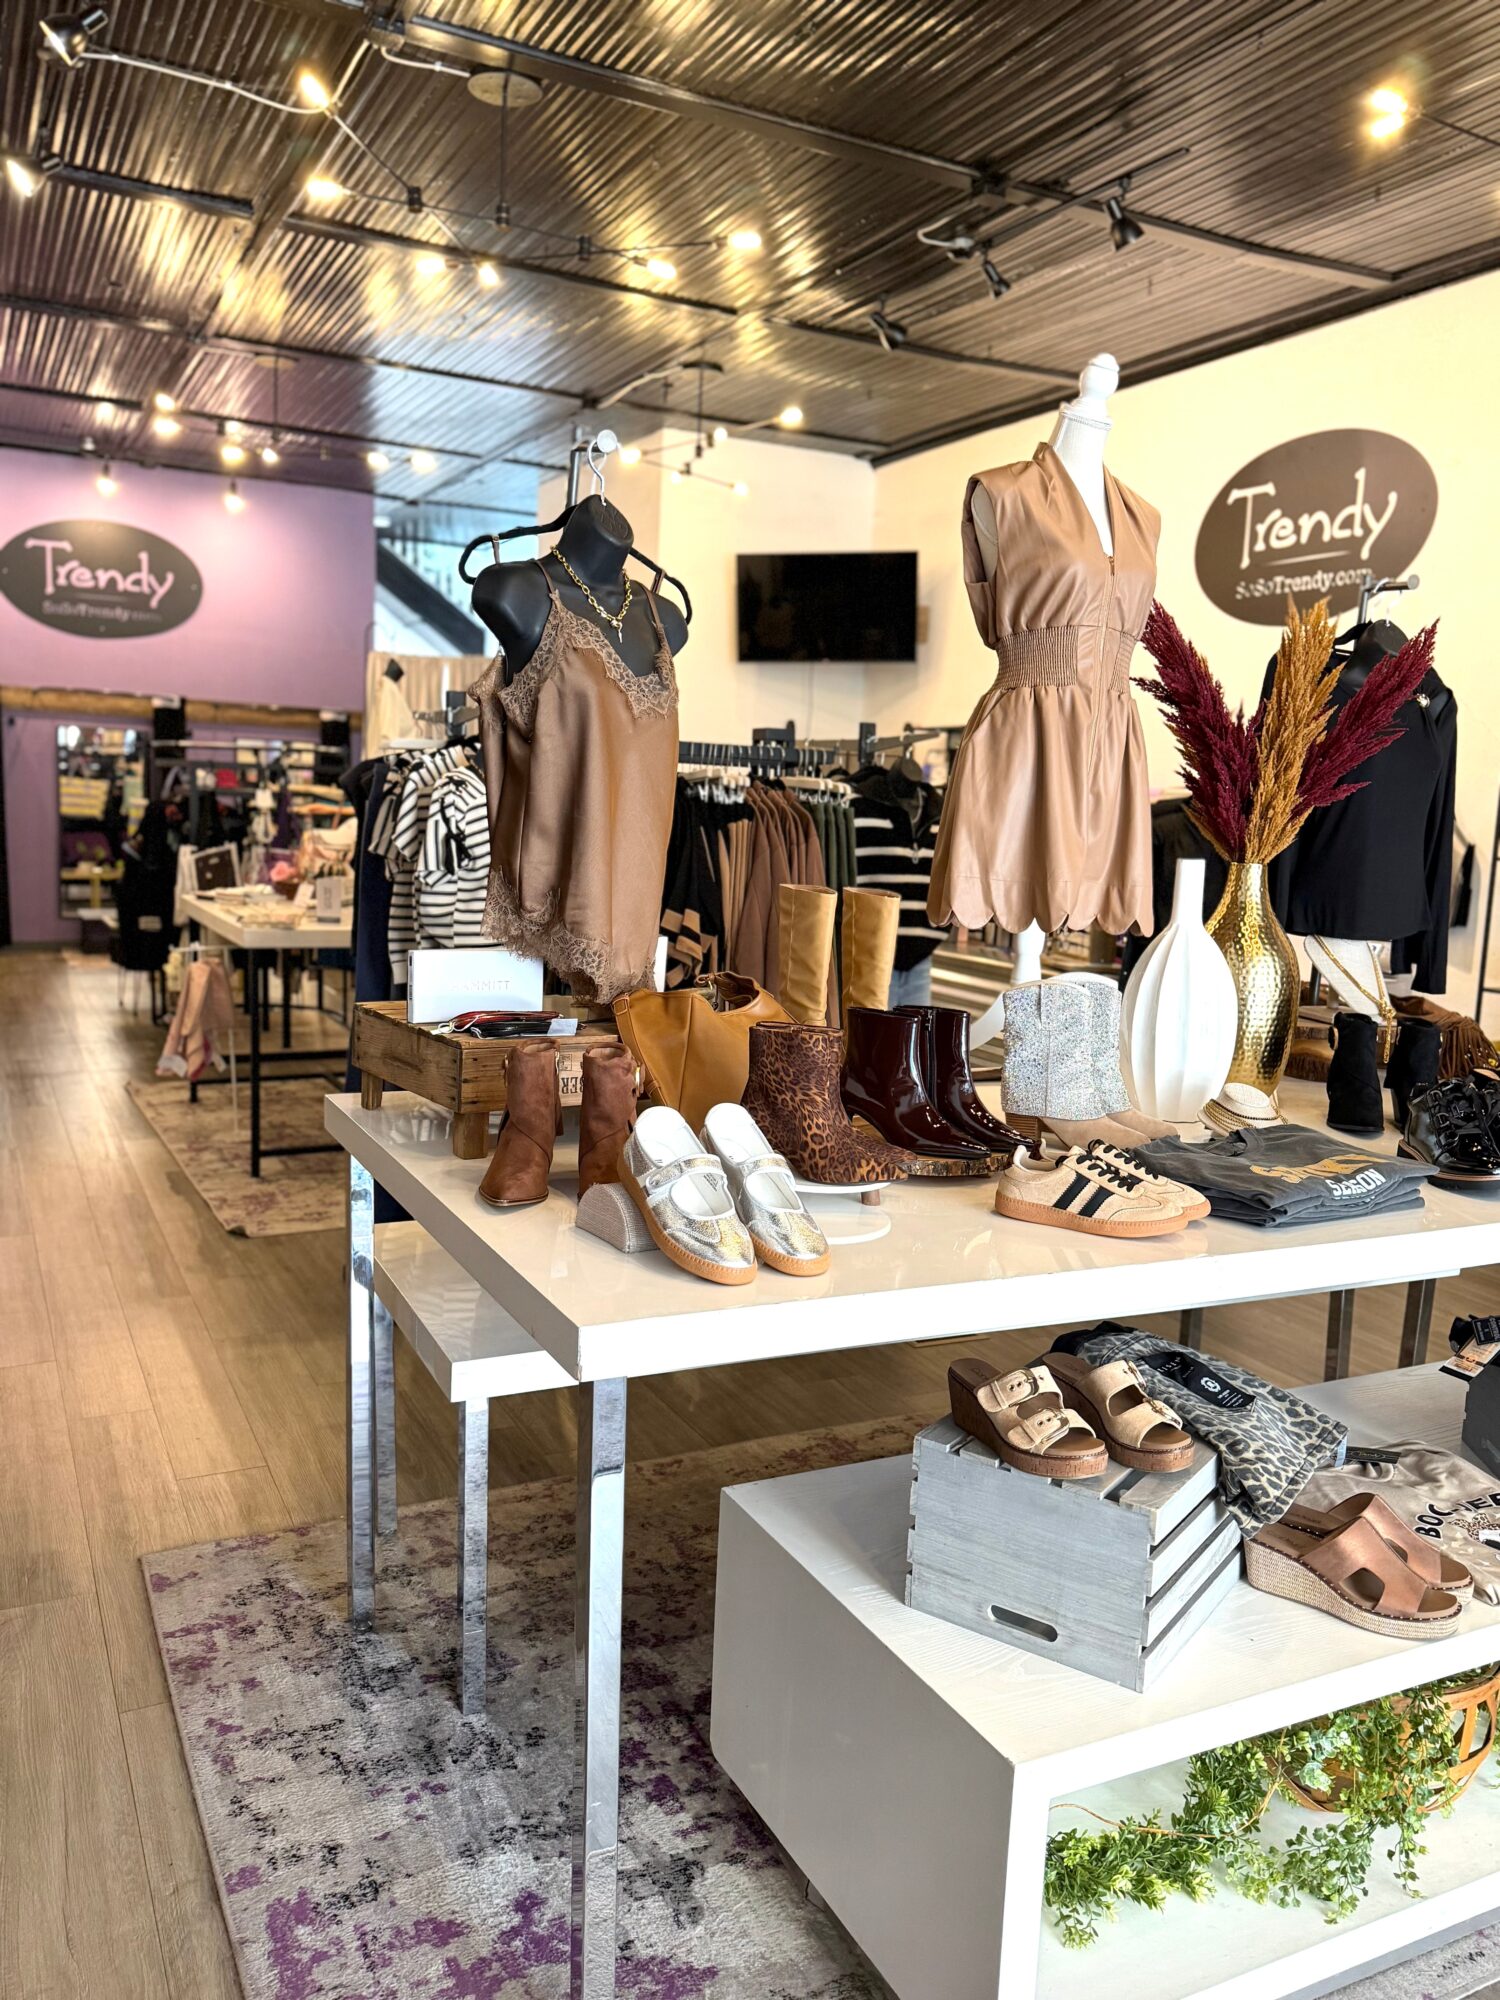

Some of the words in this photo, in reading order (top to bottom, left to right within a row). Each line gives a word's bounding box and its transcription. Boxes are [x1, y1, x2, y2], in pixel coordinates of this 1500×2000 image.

[1226, 467, 1398, 570] Trendy
[25, 537, 174, 609] Trendy
[451, 979, 511, 992] AMMITT
